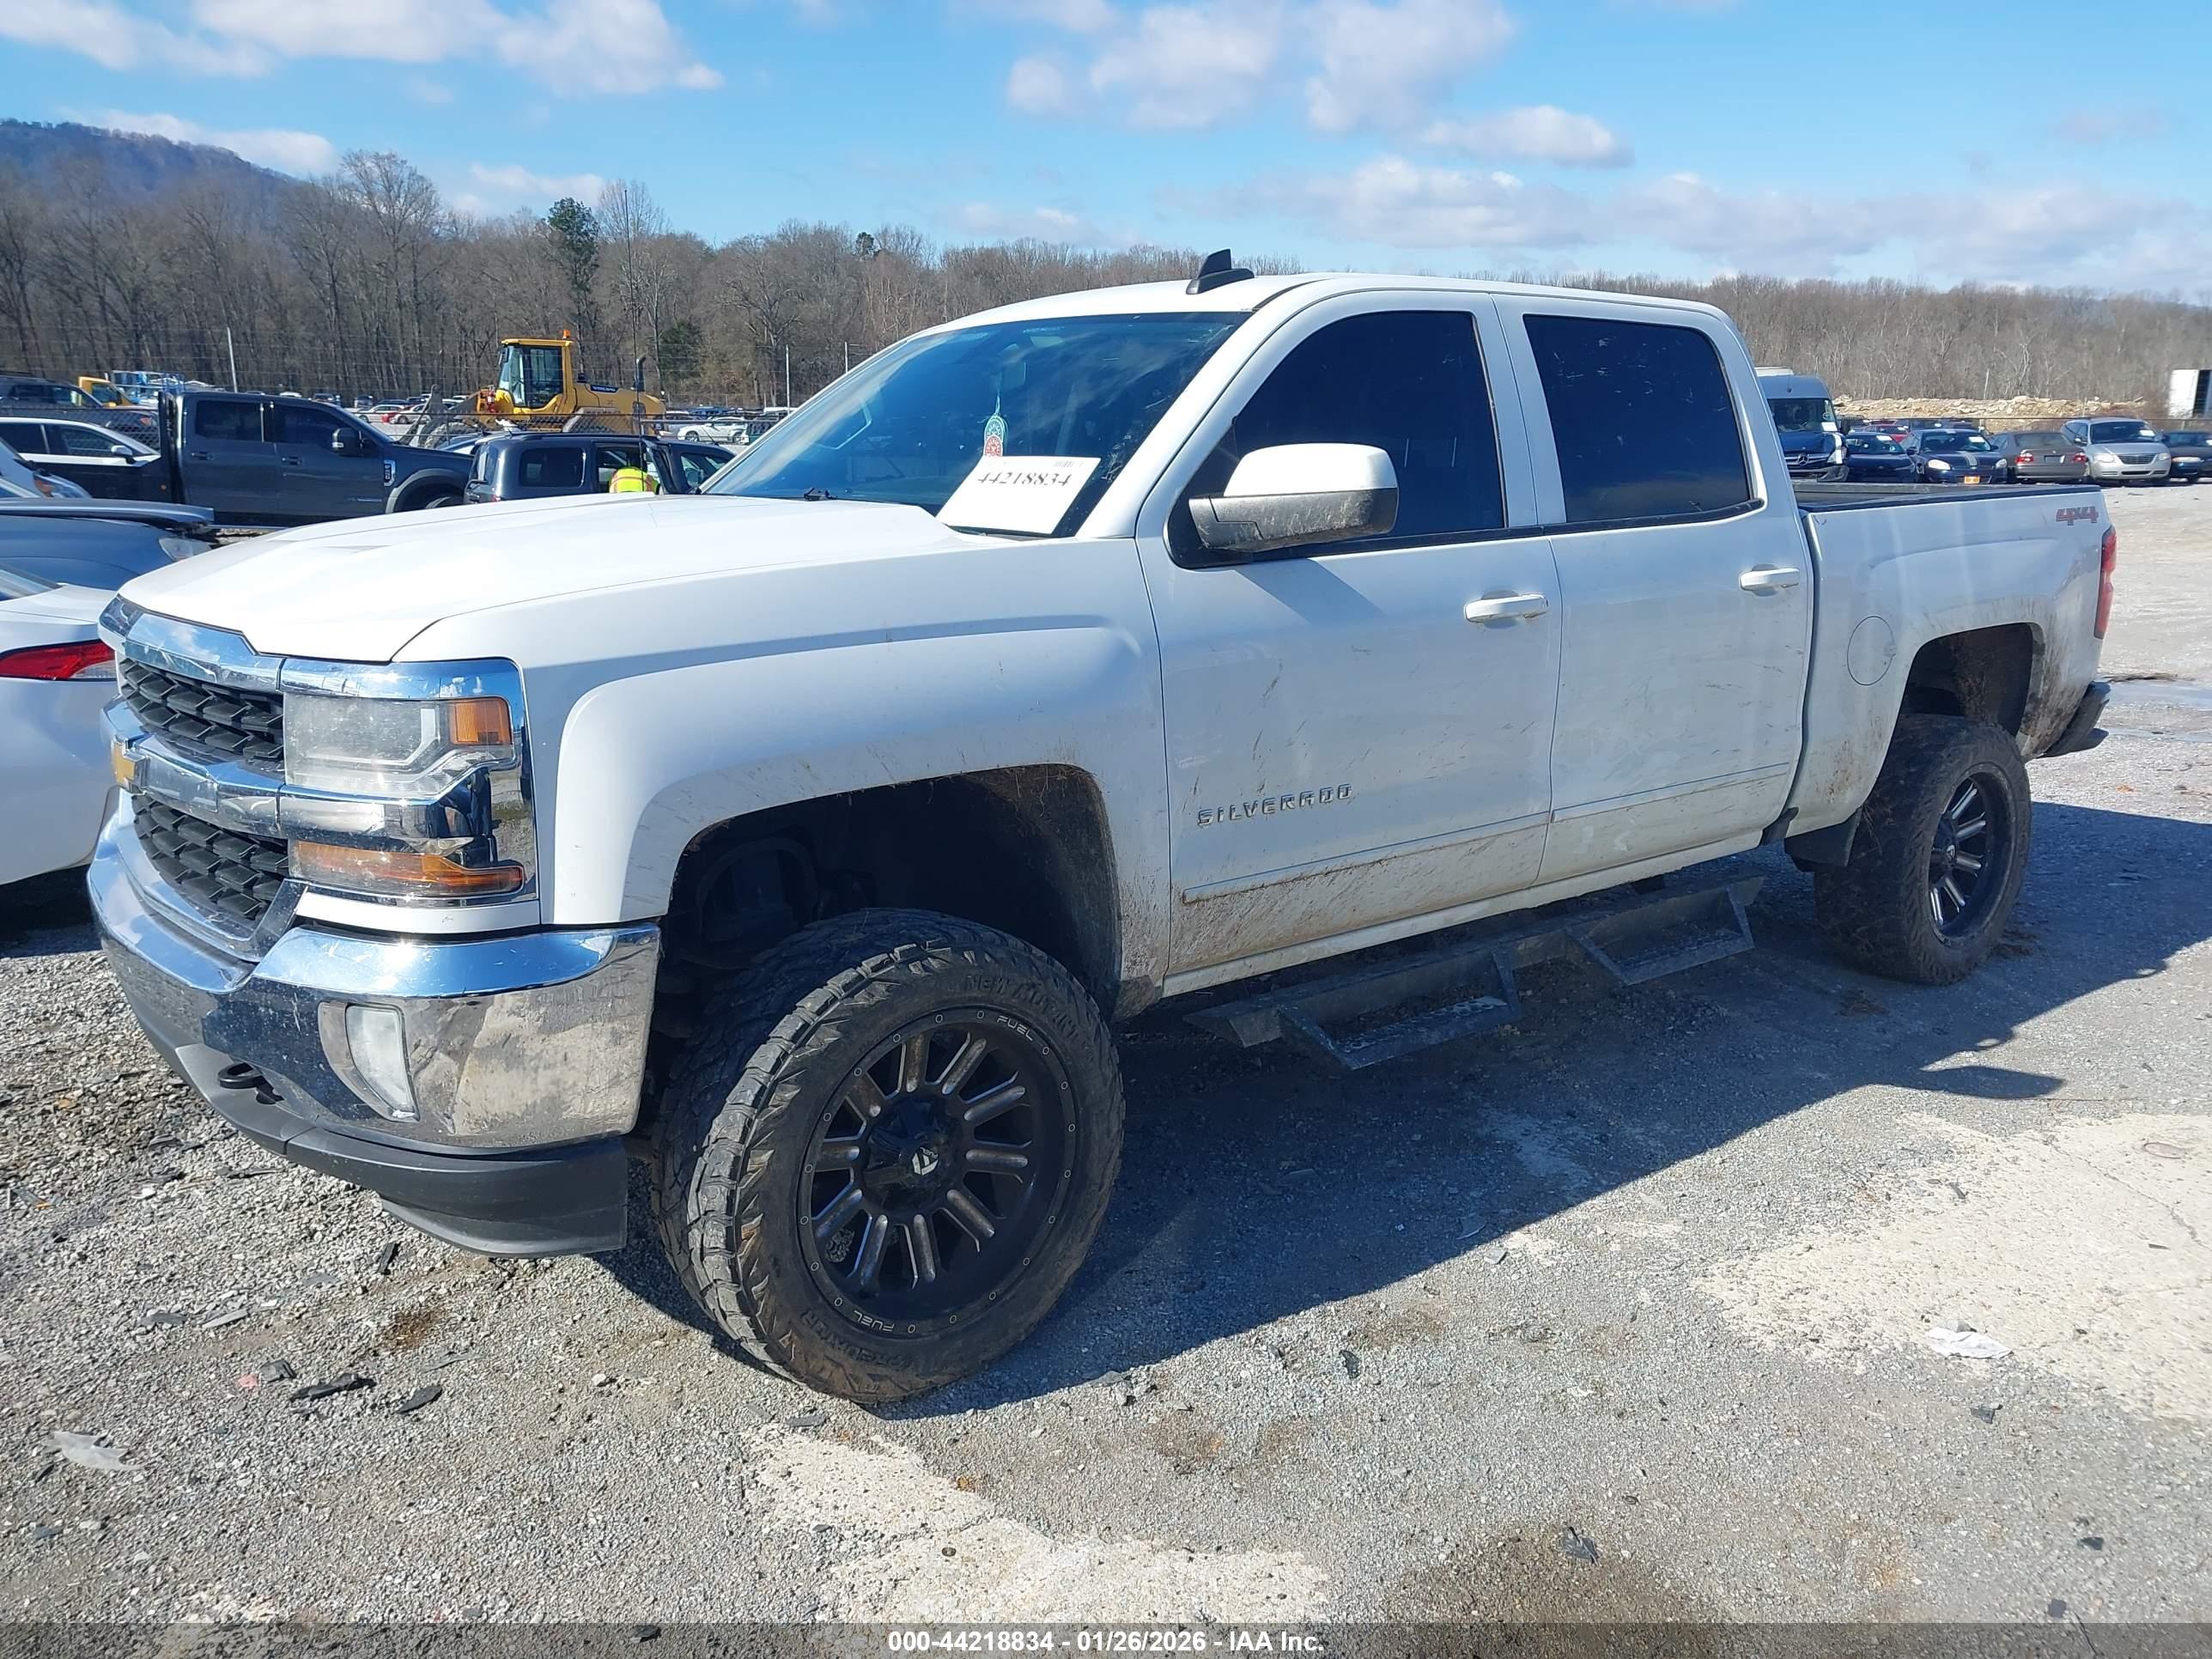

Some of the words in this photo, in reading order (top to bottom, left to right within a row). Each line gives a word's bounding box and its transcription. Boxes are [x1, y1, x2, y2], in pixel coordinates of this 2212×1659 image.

[977, 471, 1072, 486] 44218834
[1197, 783, 1353, 828] SILVERADO
[996, 1015, 1033, 1042] FUEL
[854, 1310, 895, 1332] FUEL
